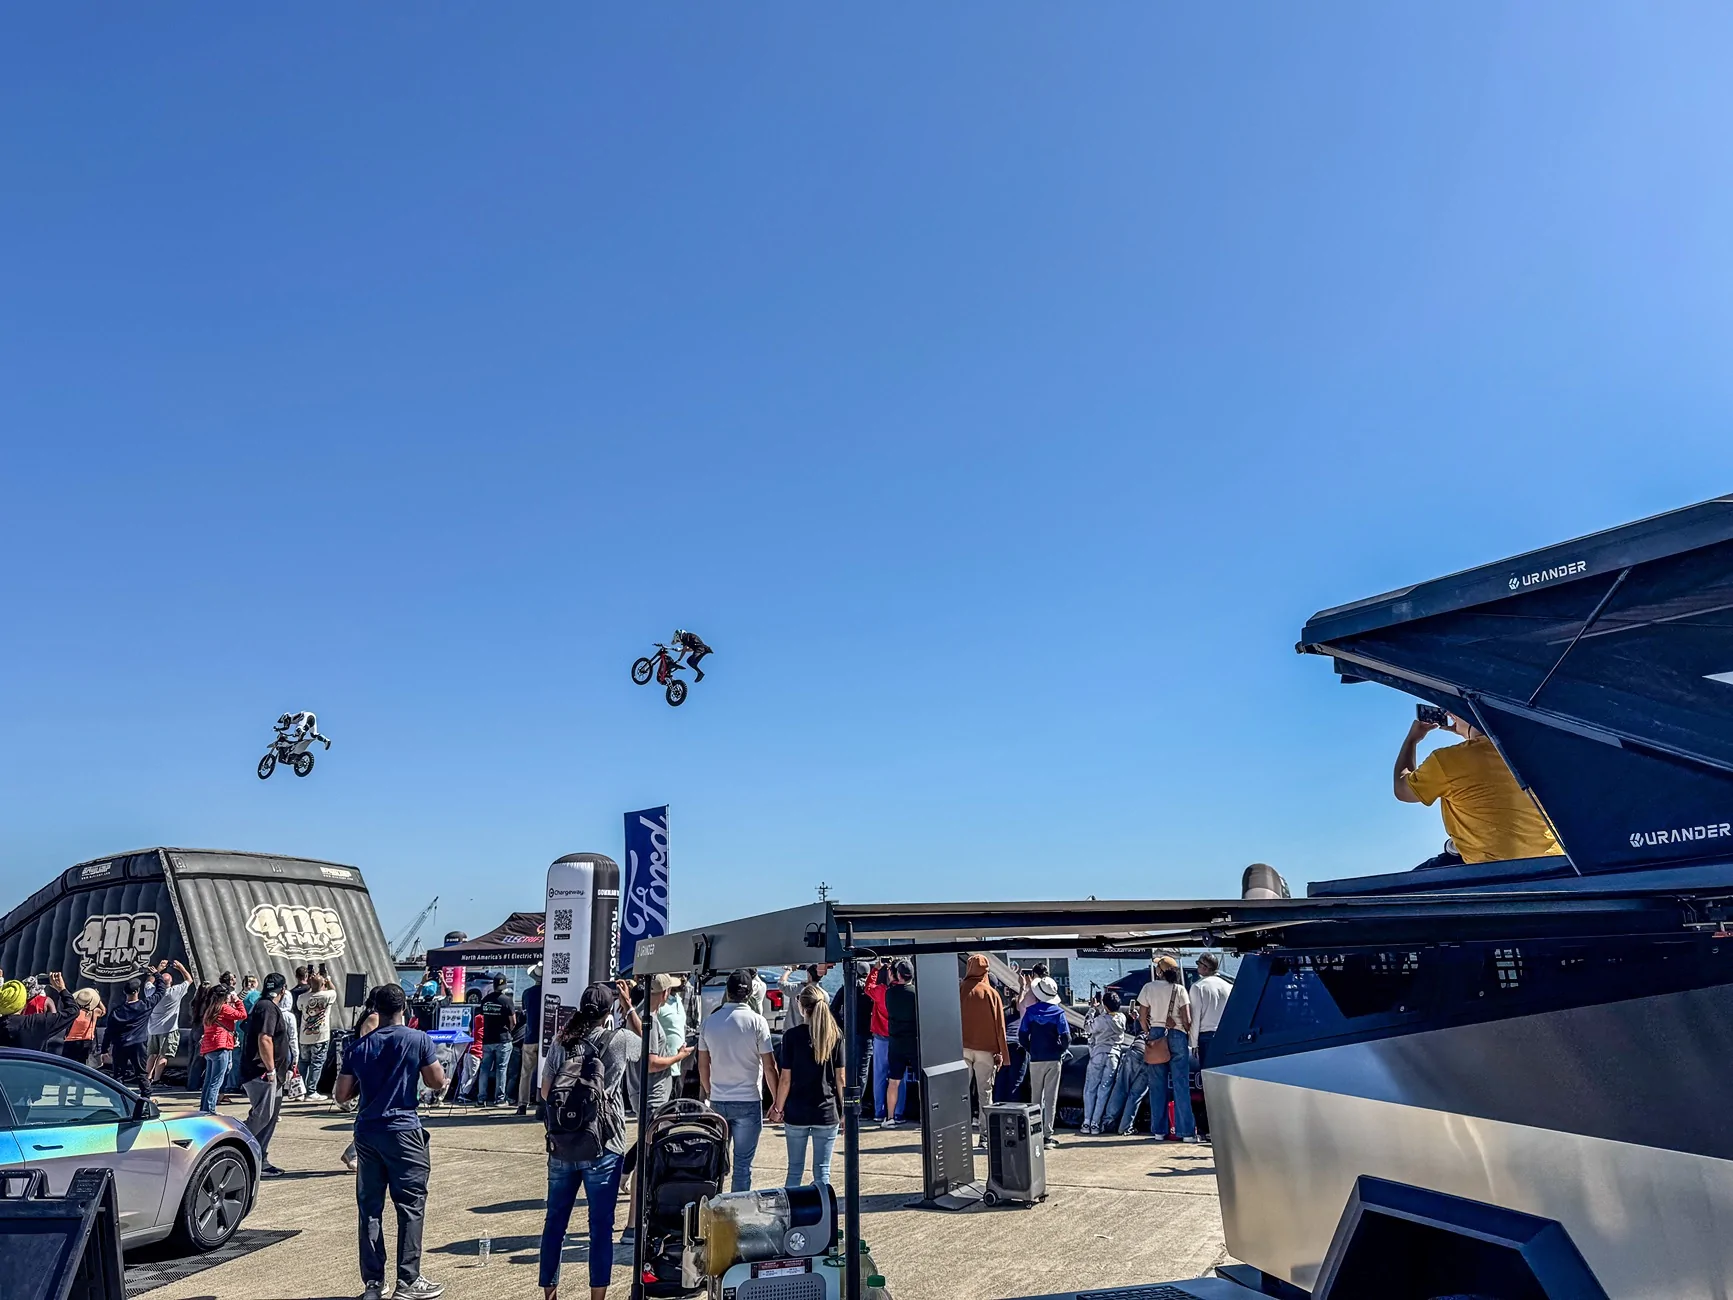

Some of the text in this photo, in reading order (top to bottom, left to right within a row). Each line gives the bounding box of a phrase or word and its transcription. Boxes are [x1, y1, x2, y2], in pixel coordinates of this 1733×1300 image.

[1522, 560, 1587, 586] URANDER
[1645, 823, 1731, 845] URANDER
[624, 815, 667, 936] Ford
[99, 948, 134, 965] FMX
